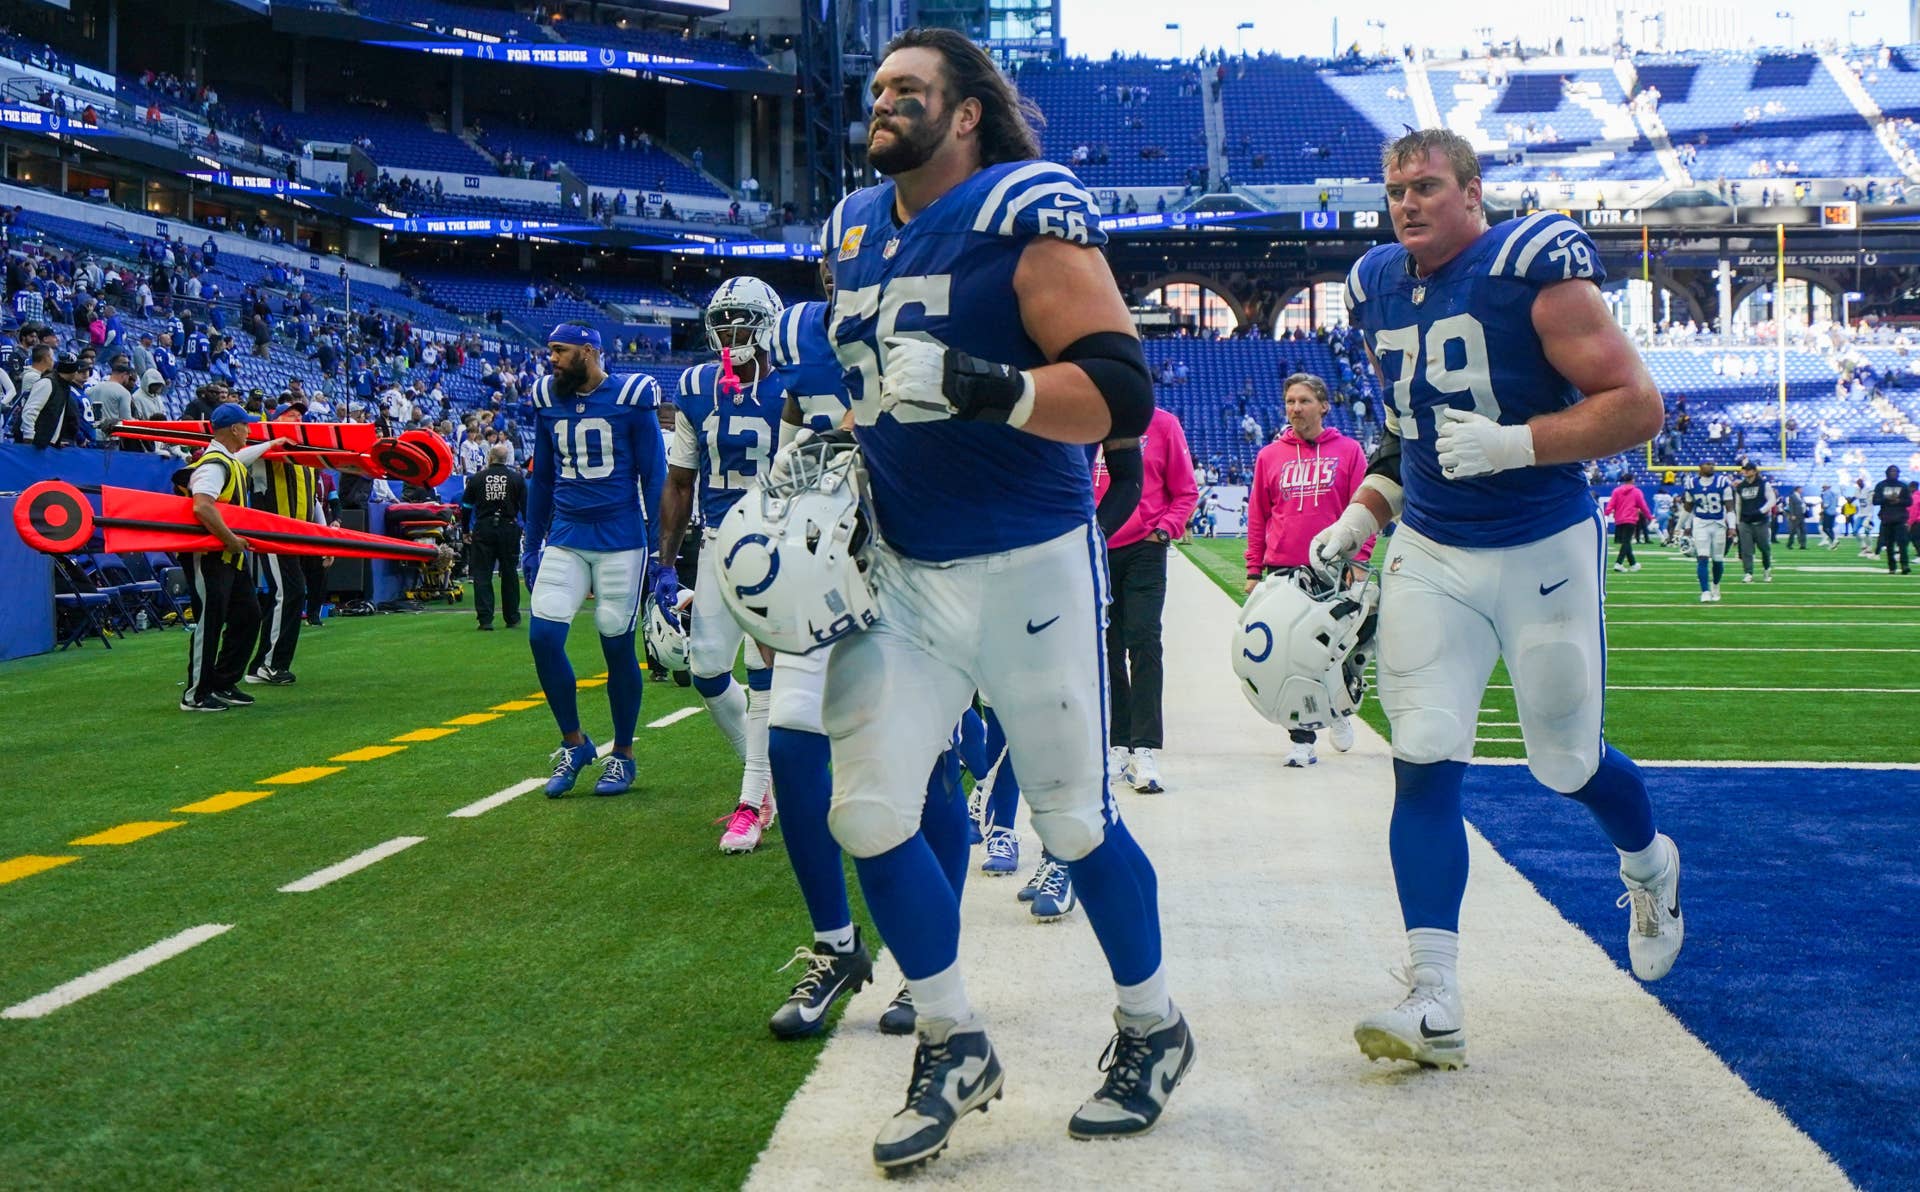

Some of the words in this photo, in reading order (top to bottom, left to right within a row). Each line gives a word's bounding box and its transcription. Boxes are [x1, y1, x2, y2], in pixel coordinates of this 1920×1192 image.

[507, 49, 531, 61] FOR
[532, 49, 556, 61] THE
[557, 50, 588, 62] SHOE
[4, 109, 20, 122] THE
[21, 111, 42, 124] SHOE
[1099, 219, 1117, 229] FOR
[1118, 217, 1137, 228] THE
[1138, 214, 1163, 225] SHOE
[1354, 211, 1379, 228] 20
[1590, 210, 1621, 225] QTR
[1623, 210, 1636, 222] 4
[427, 220, 446, 231] FOR
[447, 221, 466, 231] THE
[467, 220, 491, 230] SHOE
[1038, 208, 1089, 244] 56
[732, 246, 748, 255] FOR
[749, 245, 764, 254] THE
[765, 244, 786, 253] SHOE
[1548, 241, 1594, 279] 79
[1739, 256, 1776, 265] LUCAS
[1799, 255, 1856, 265] STADIUM
[828, 274, 951, 426] 56
[1375, 313, 1501, 440] 79
[553, 418, 615, 480] 10
[702, 416, 772, 489] 13
[486, 475, 508, 483] CSC
[1282, 461, 1334, 488] COLTS
[485, 484, 507, 492] EVENT
[485, 492, 507, 500] STAFF
[1693, 493, 1721, 513] 38
